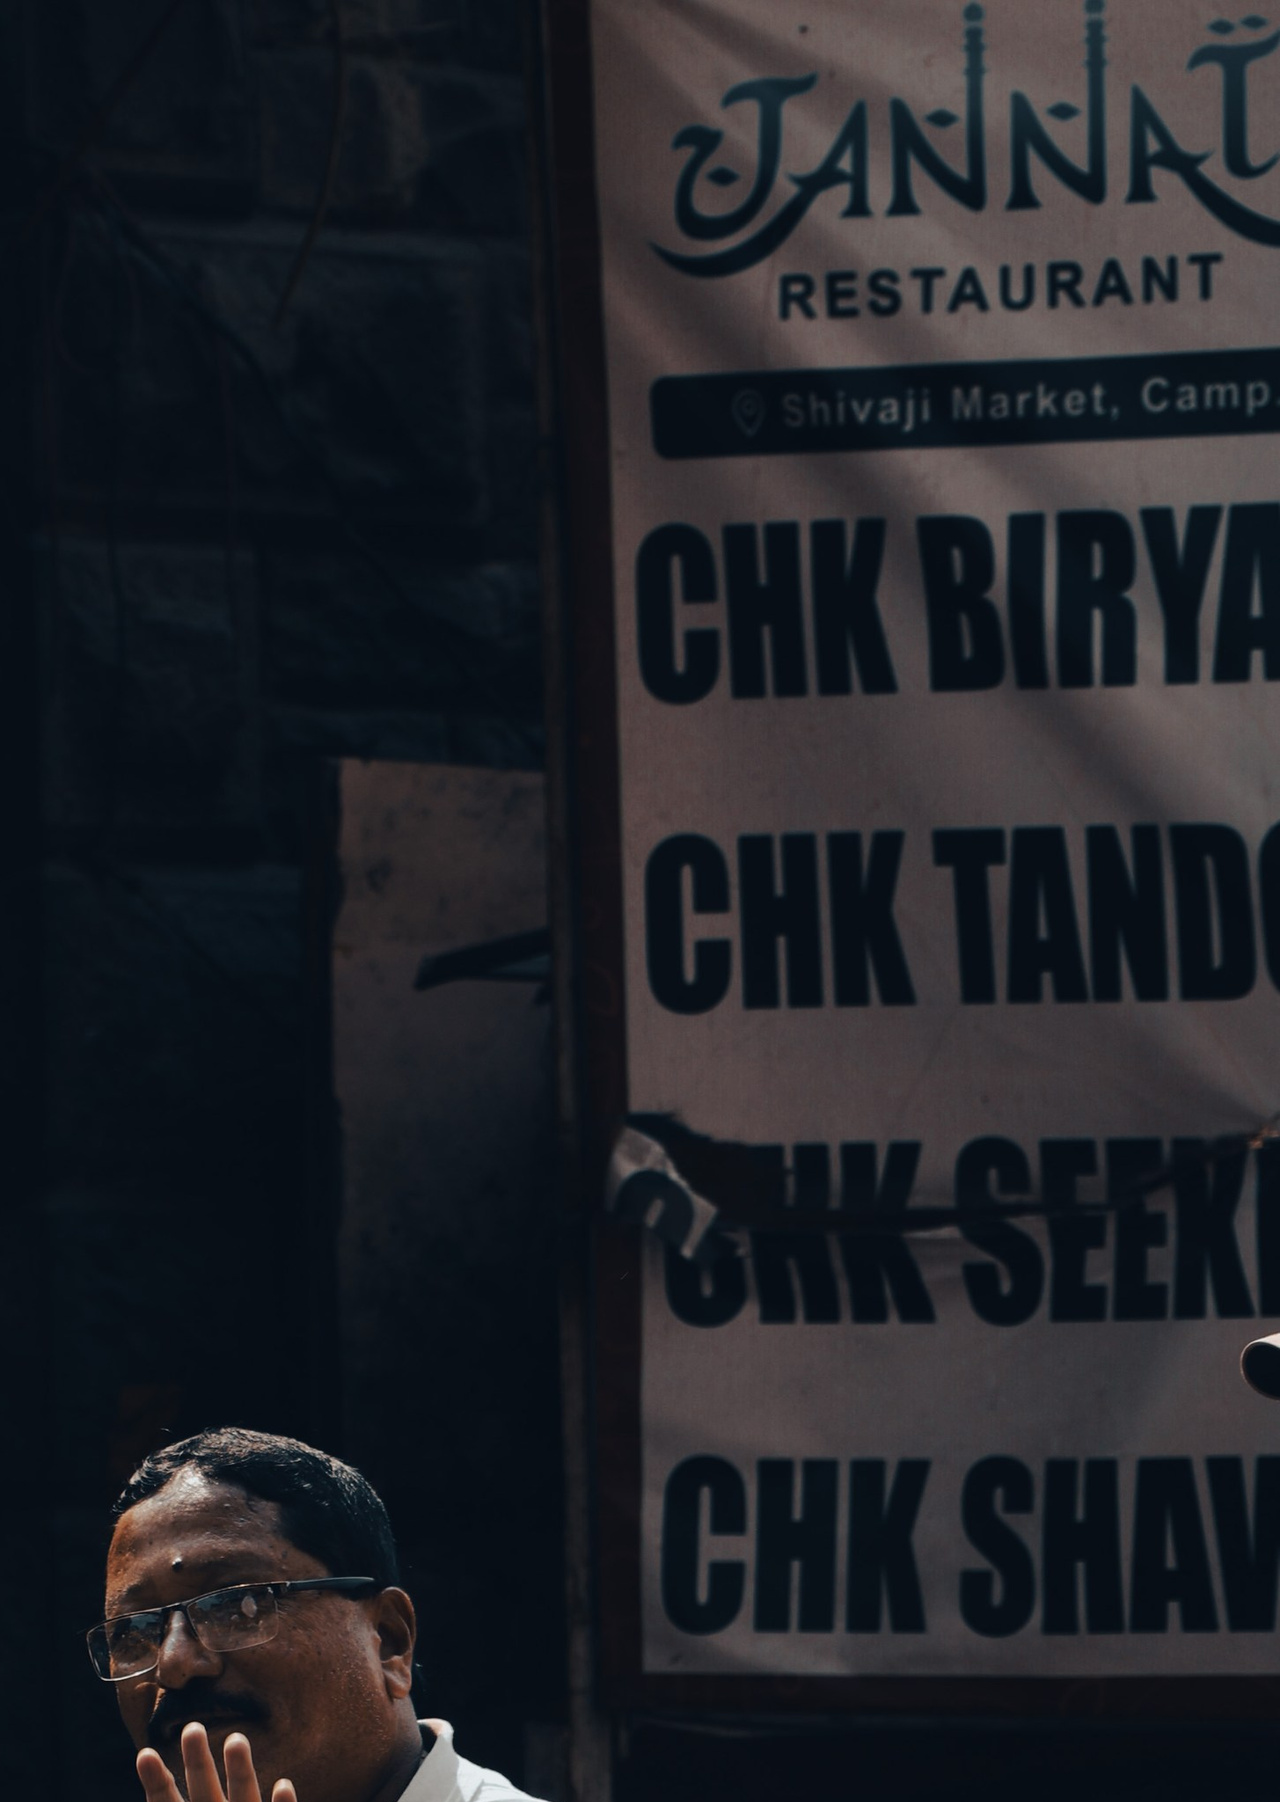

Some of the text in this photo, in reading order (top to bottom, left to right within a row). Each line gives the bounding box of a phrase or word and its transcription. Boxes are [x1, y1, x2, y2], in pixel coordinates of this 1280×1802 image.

[647, 0, 1280, 278] JANNAT
[778, 252, 1222, 320] RESTAURANT
[782, 388, 931, 432] Shivaji
[951, 379, 1119, 421] Market,
[635, 502, 1280, 705] CHK BIRYA
[644, 822, 1280, 1016] CHK TAND
[661, 1454, 932, 1637] CHK
